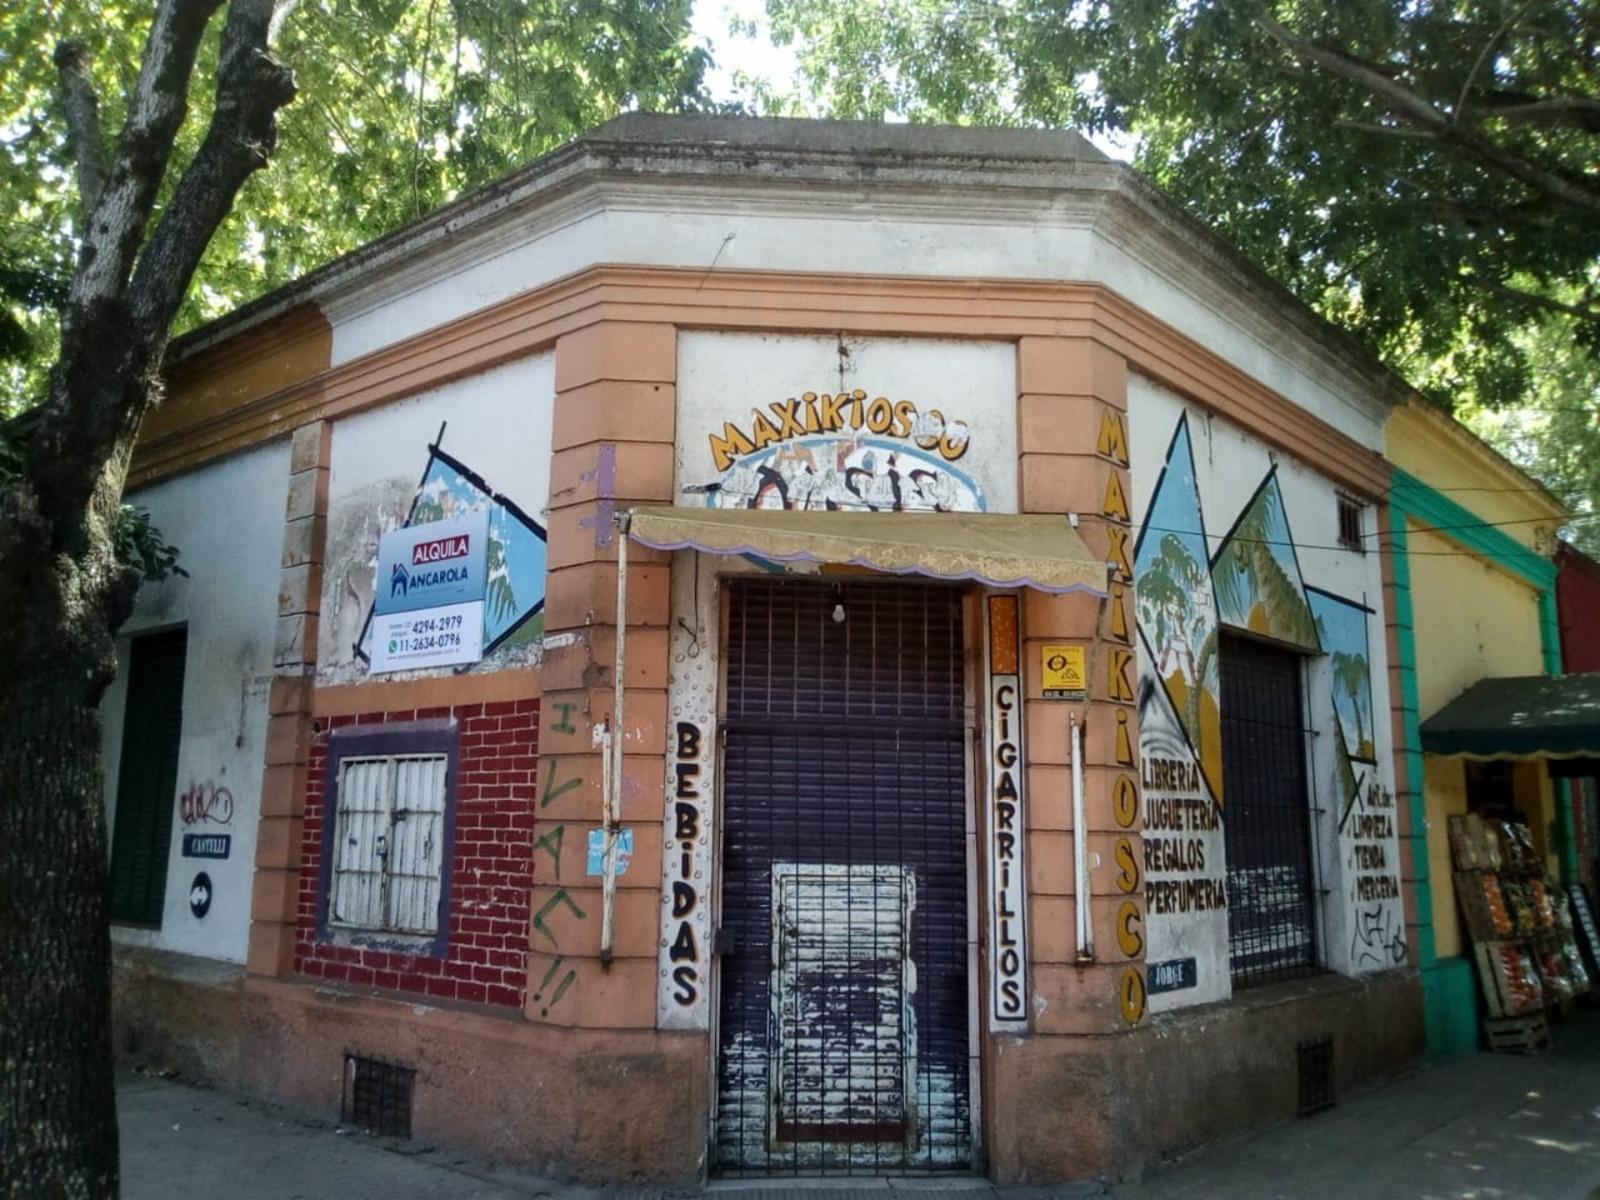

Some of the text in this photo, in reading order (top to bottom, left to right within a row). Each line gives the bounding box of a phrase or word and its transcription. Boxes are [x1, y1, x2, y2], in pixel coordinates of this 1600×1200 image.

[414, 538, 468, 563] ALQUILA
[412, 616, 462, 634] 4294-2979
[401, 634, 461, 652] 11-2634-0796
[1142, 757, 1200, 793] LIBRERIA
[1143, 797, 1220, 832] JUGUETERIA
[1353, 814, 1393, 839] LIMPIEZA
[670, 721, 700, 1006] BEBIDAS
[995, 685, 1020, 1014] CIGARRILLOS
[1144, 837, 1205, 872] REGALOS
[1354, 845, 1386, 870] TIENDA
[1145, 877, 1226, 914] PERFUMERIA
[1356, 874, 1399, 901] MERCERIA
